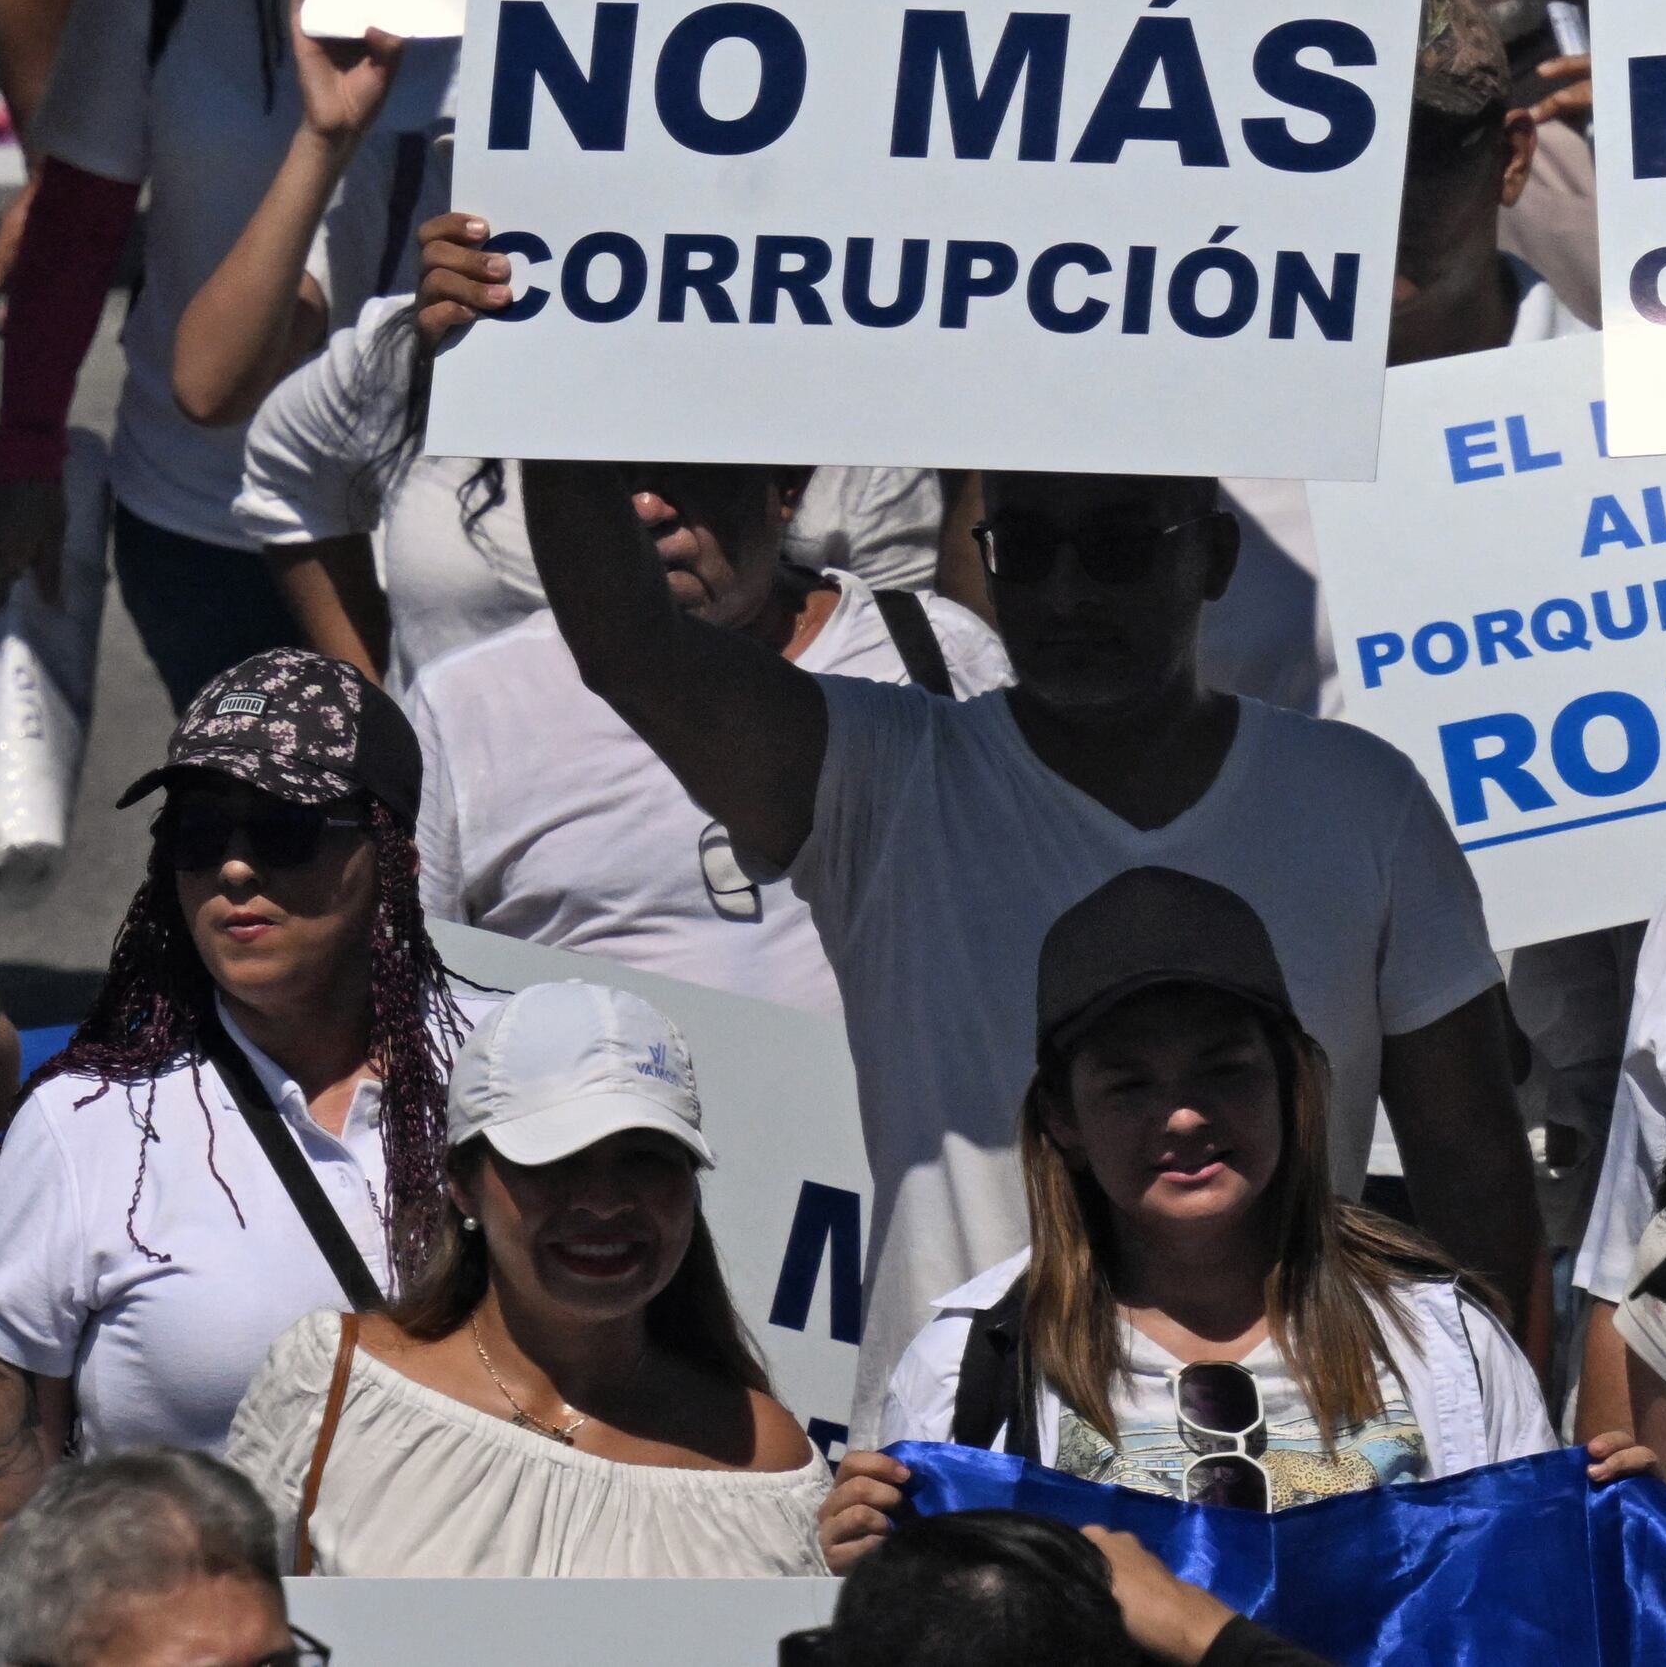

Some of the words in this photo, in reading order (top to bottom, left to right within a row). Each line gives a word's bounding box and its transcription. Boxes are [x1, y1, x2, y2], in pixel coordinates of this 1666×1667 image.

[487, 0, 808, 157] NO
[480, 225, 1361, 343] CORRUPCIÓN
[1444, 412, 1563, 486] EL
